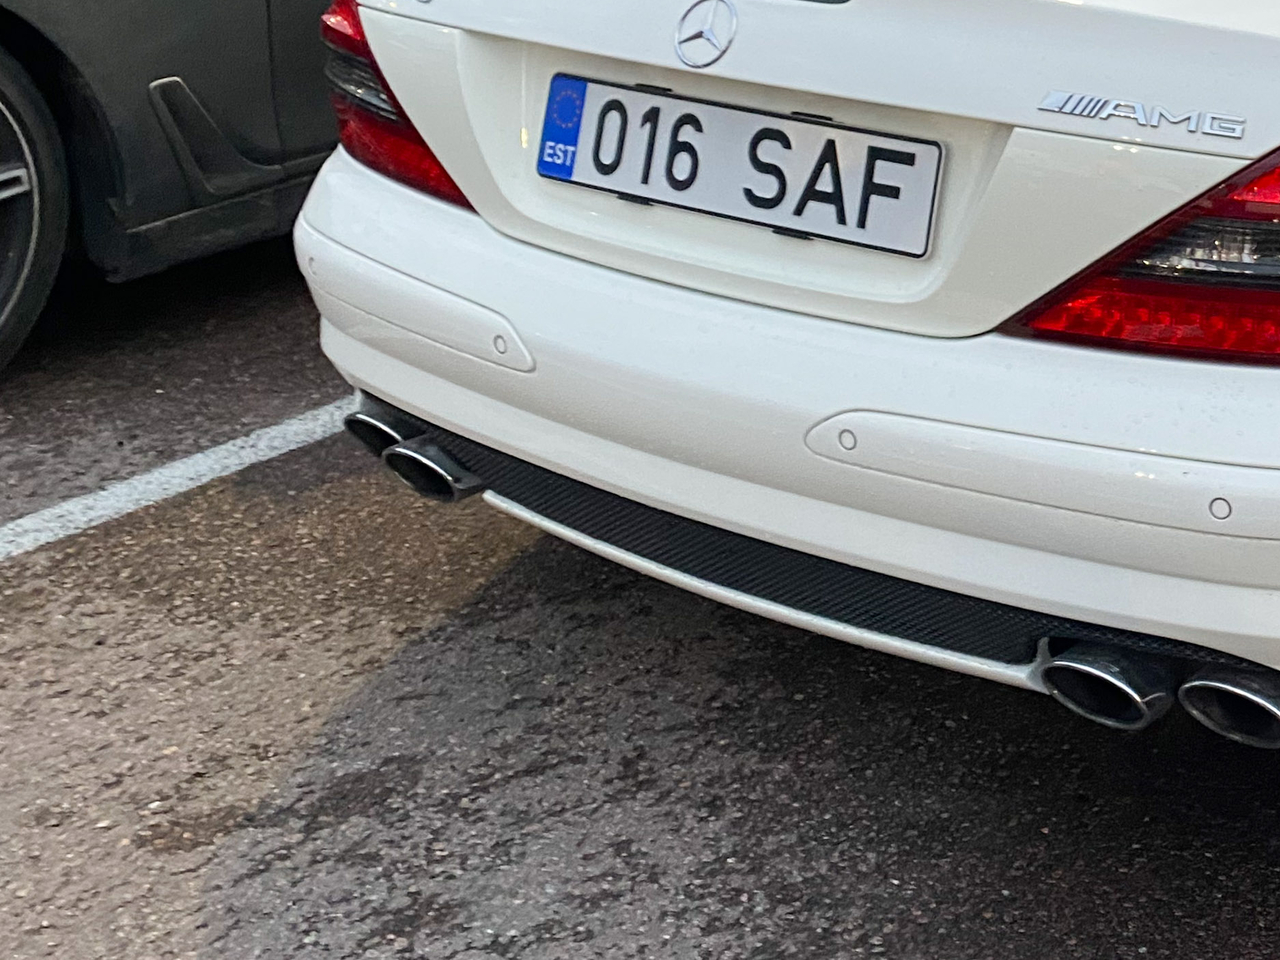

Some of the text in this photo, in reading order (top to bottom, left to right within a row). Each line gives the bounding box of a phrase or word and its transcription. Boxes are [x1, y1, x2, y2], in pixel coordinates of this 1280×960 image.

[1099, 99, 1246, 139] AMG
[543, 141, 576, 166] EST
[592, 98, 915, 229] 016 SAF
